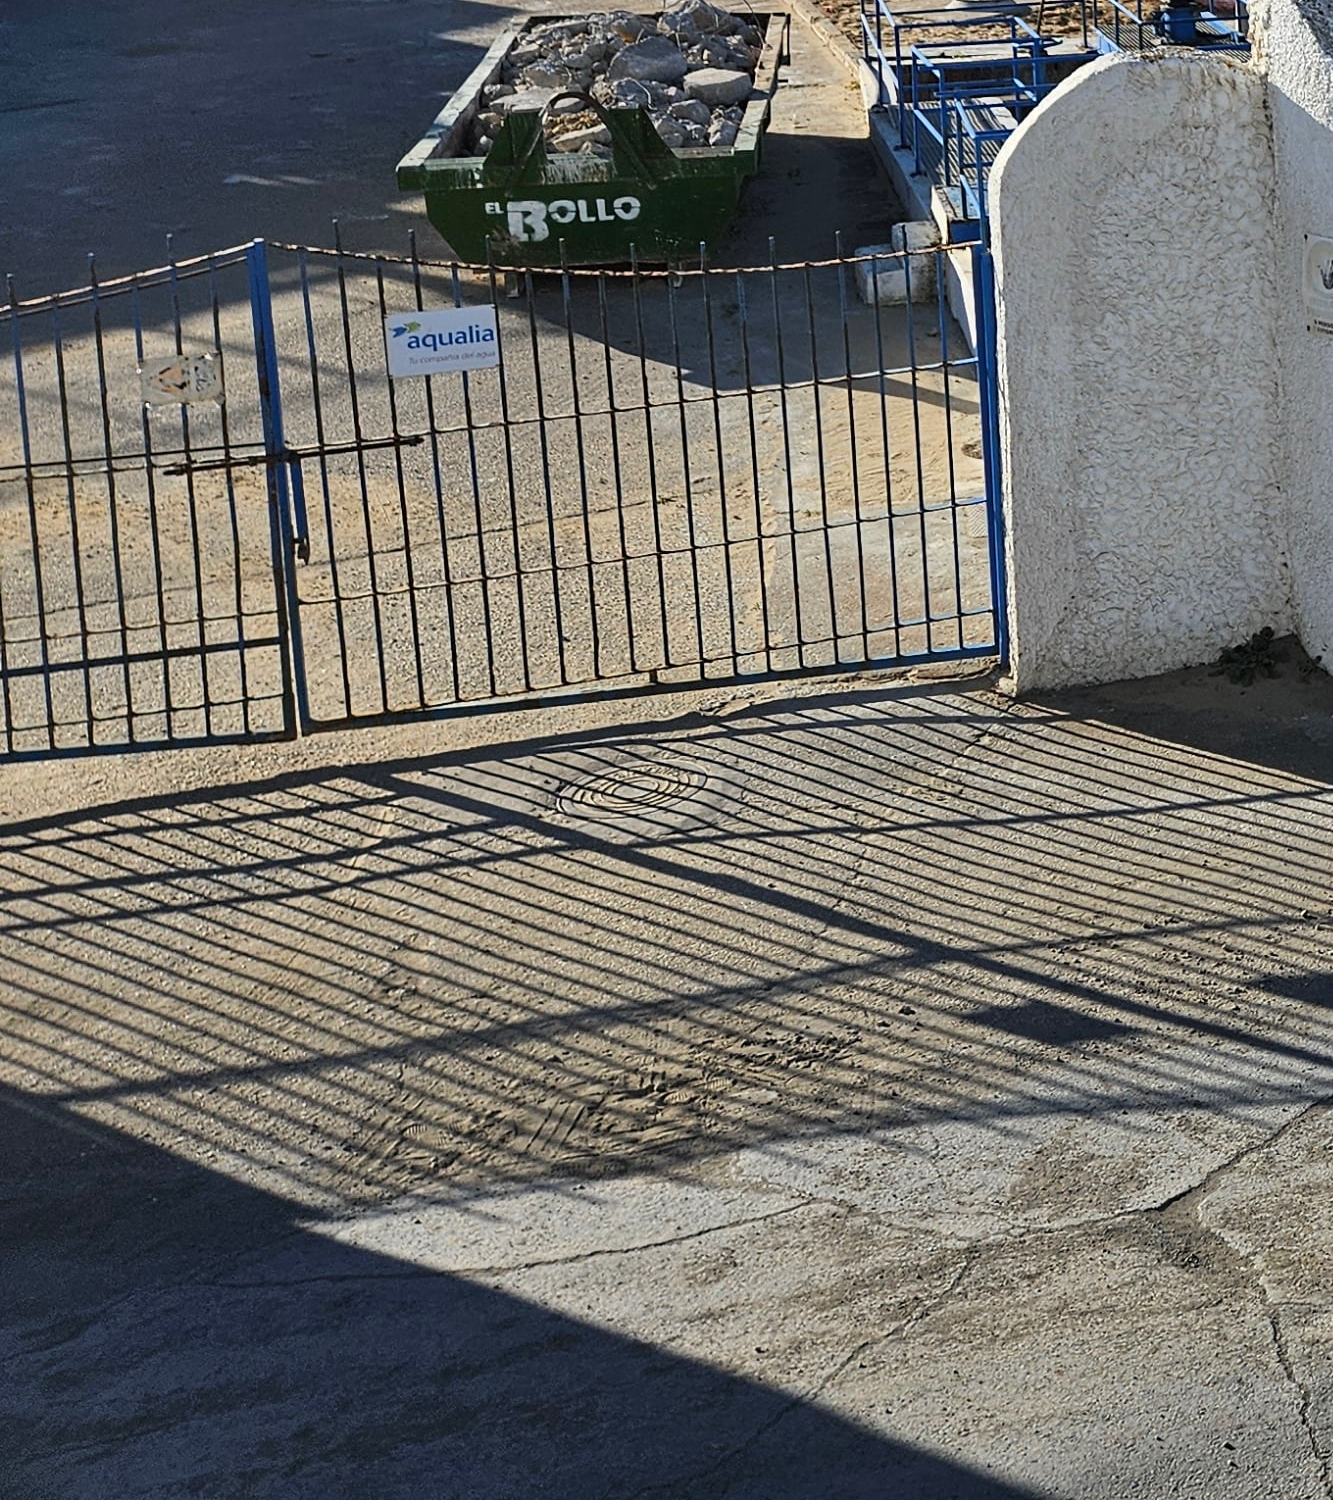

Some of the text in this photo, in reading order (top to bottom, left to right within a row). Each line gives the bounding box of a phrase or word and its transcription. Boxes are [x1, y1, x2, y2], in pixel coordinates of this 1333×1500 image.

[484, 196, 641, 242] EL BOLLO
[407, 324, 494, 352] aqualia
